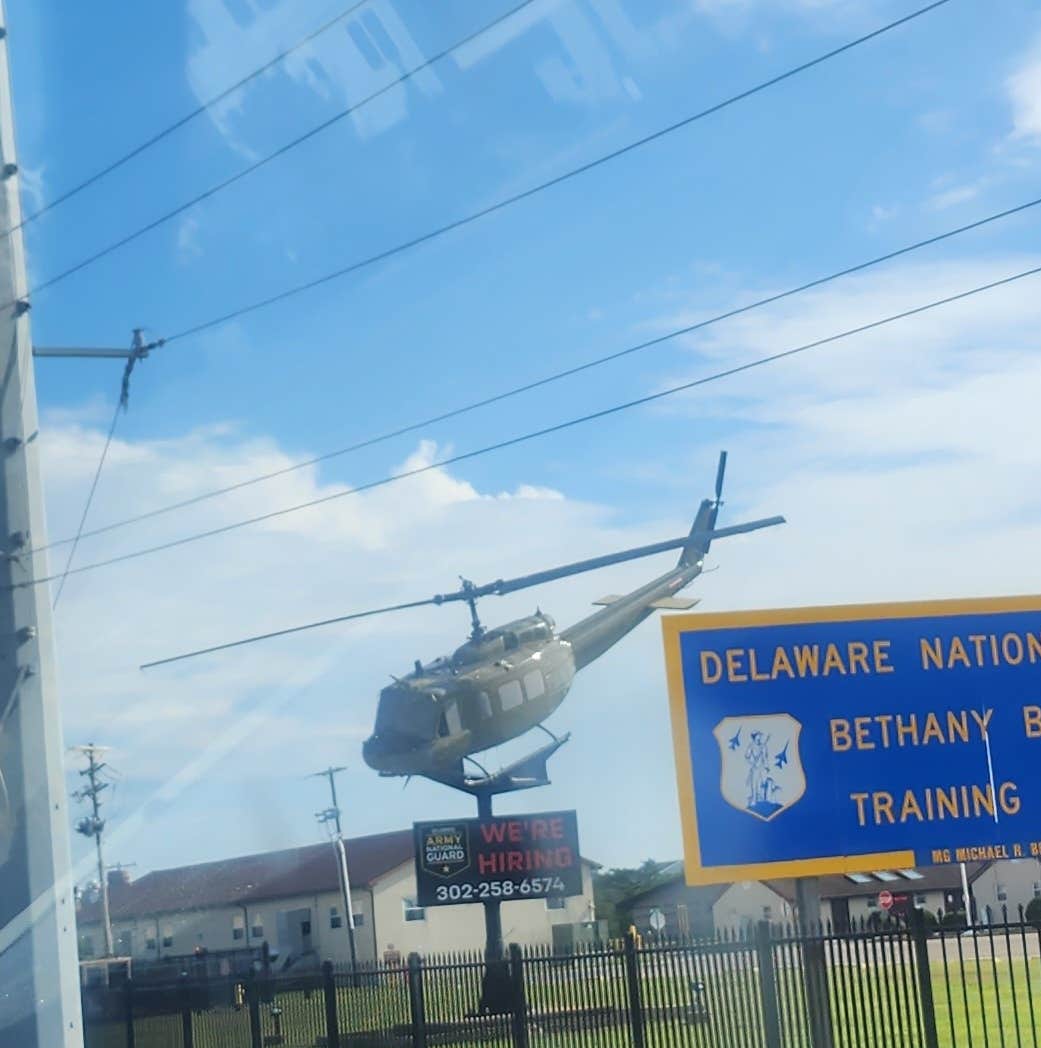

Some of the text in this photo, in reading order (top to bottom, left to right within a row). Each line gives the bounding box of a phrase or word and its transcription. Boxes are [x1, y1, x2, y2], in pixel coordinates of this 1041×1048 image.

[700, 641, 894, 684] DELAWARE
[830, 709, 993, 752] BETHANY
[851, 781, 1021, 826] TRAINING
[426, 833, 462, 846] ARMY
[480, 818, 564, 844] WE'RE
[426, 844, 464, 852] NATIONAL
[426, 850, 465, 862] GUARD
[932, 850, 950, 863] MG
[955, 846, 1008, 861] MICHAEL
[478, 848, 572, 875] HIRING
[436, 877, 565, 901] 302-258-6574
